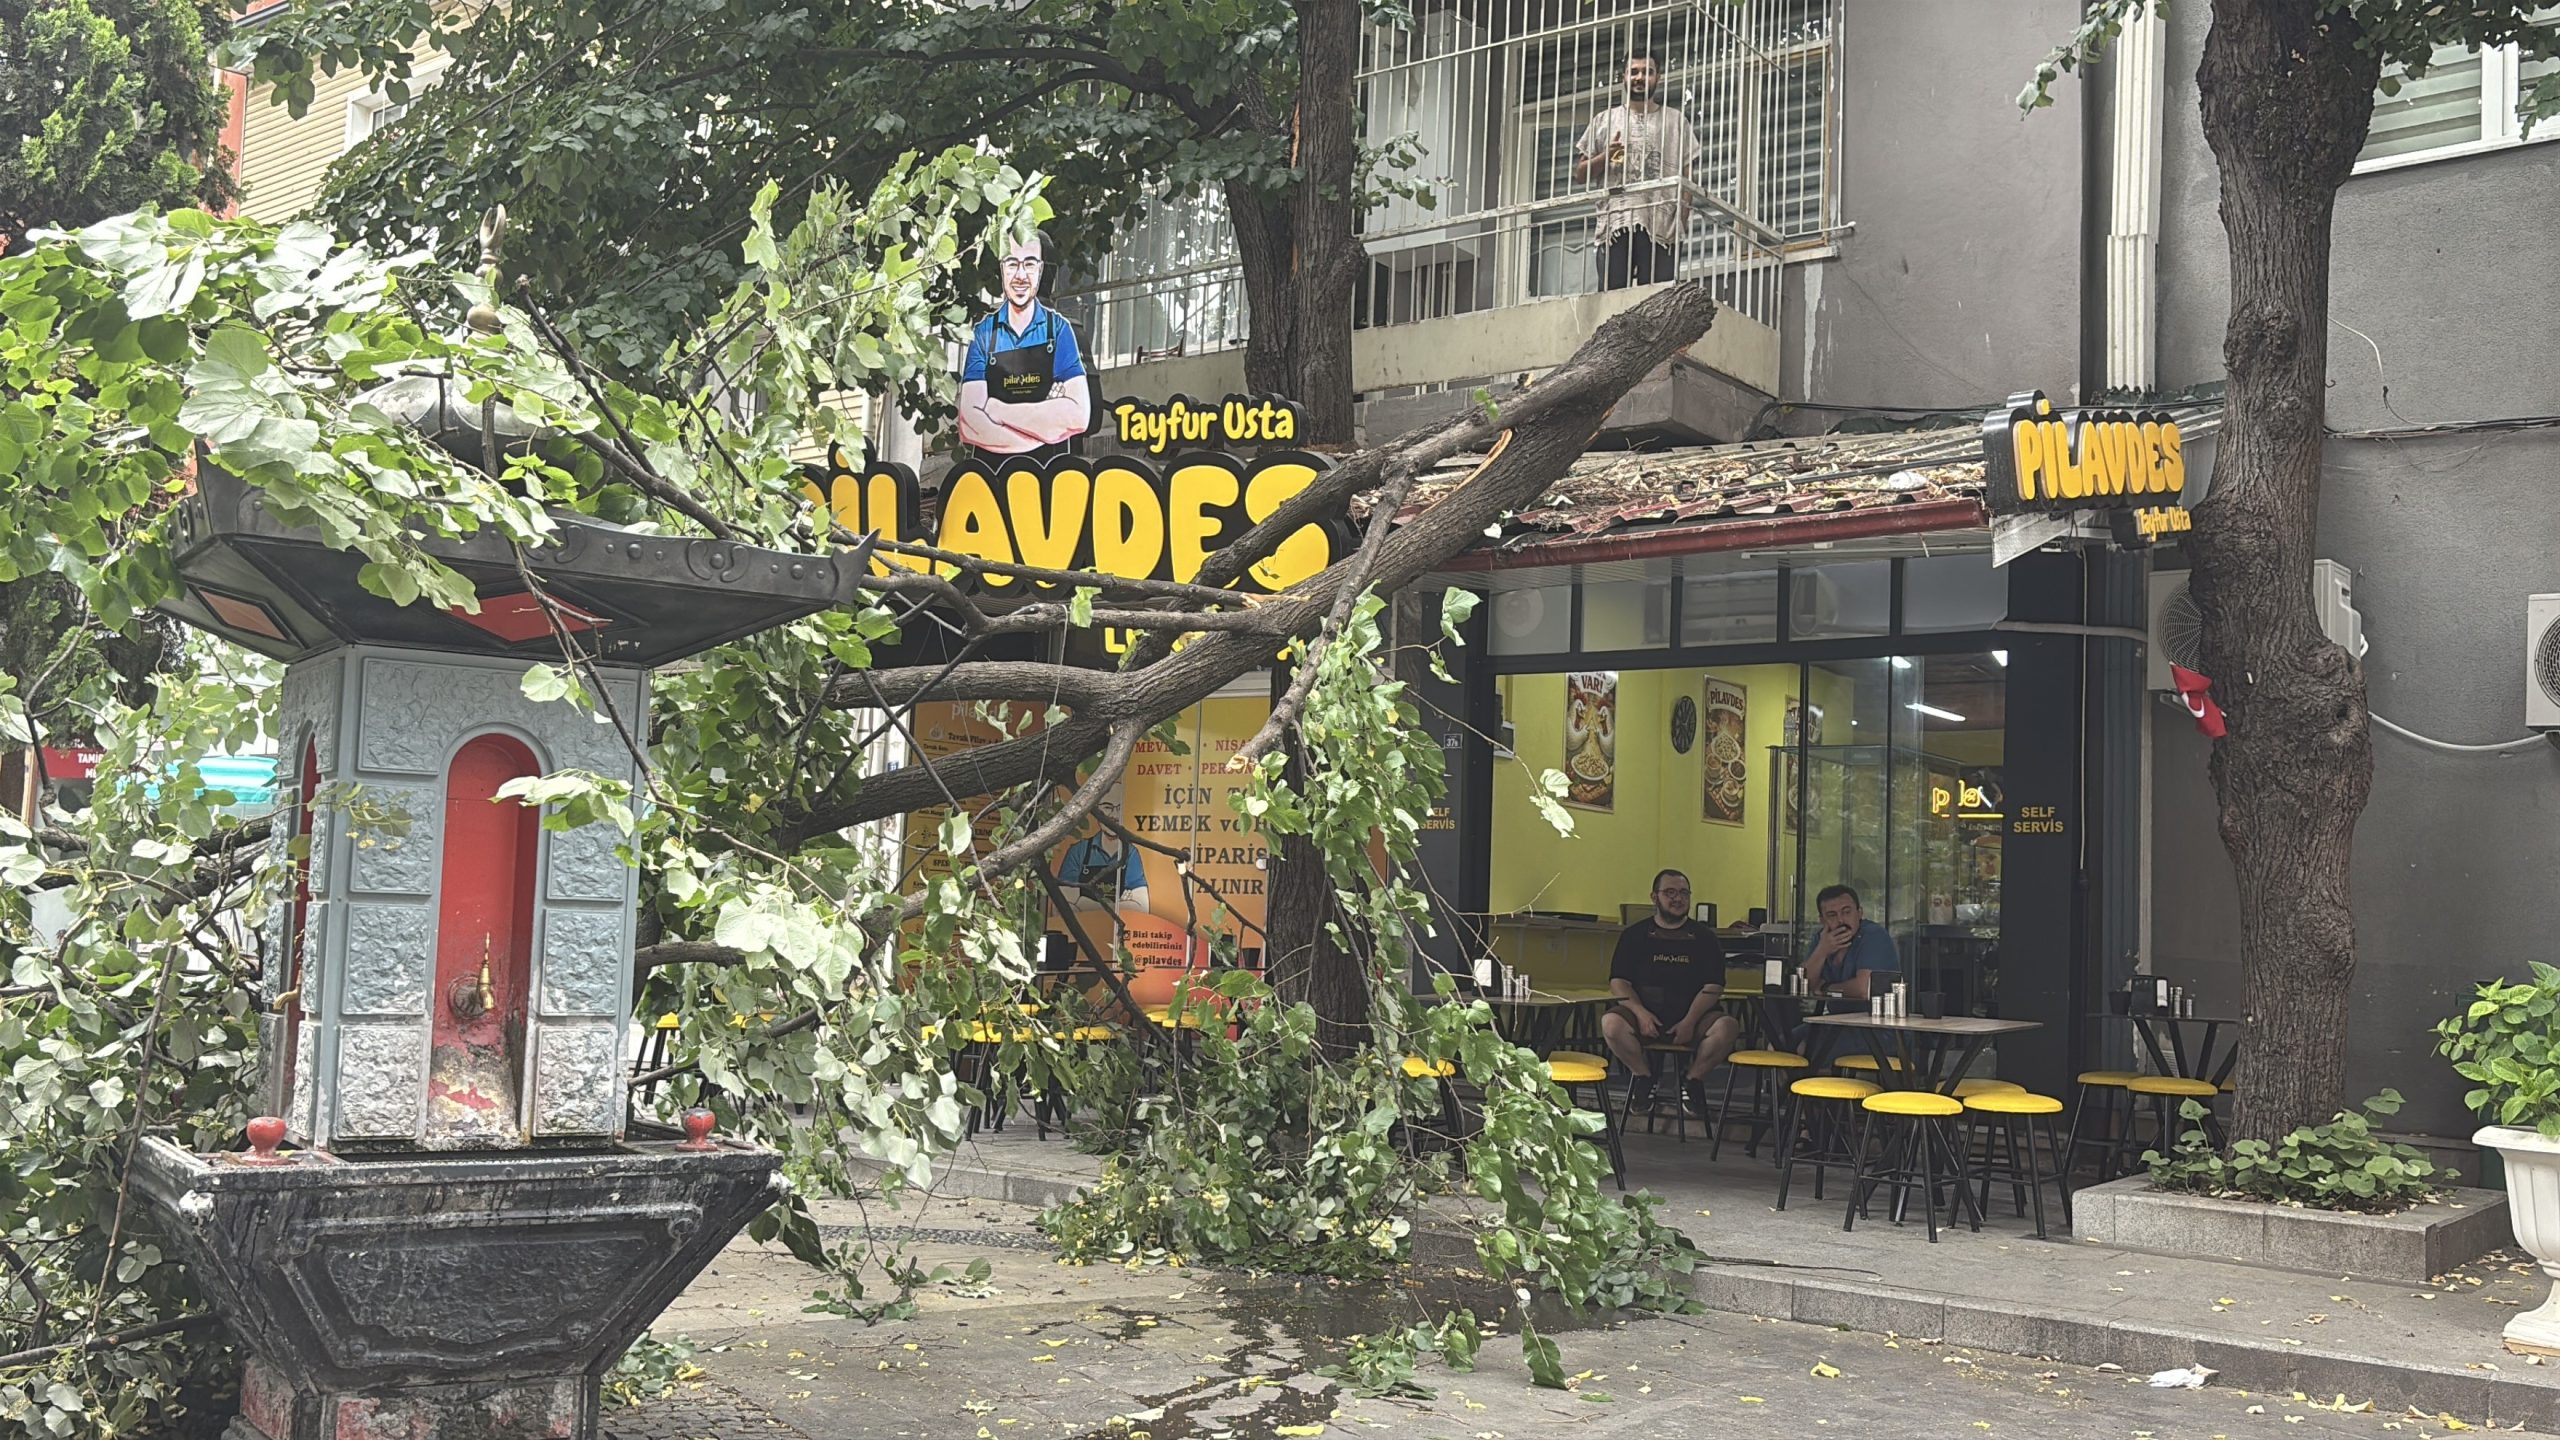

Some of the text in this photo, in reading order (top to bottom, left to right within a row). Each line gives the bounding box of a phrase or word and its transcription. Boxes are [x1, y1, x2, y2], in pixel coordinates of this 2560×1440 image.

[1115, 400, 1294, 453] Tayfur Usta
[2013, 398, 2185, 500] PİLAVDES
[792, 449, 1330, 592] İLAVDES
[1710, 688, 1744, 711] PİLAVDES
[951, 700, 1013, 720] pilads
[1215, 738, 1251, 754] NİŞA
[1137, 764, 1182, 775] DAVET
[1164, 783, 1212, 809] İÇİN
[1432, 807, 1451, 817] ELF
[2021, 806, 2056, 818] SELF
[1135, 815, 1211, 832] YEMEK
[2013, 820, 2064, 833] SERVİS
[1196, 879, 1264, 895] ALINIR
[1151, 930, 1173, 941] takip
[1134, 954, 1183, 967] @pilavdes
